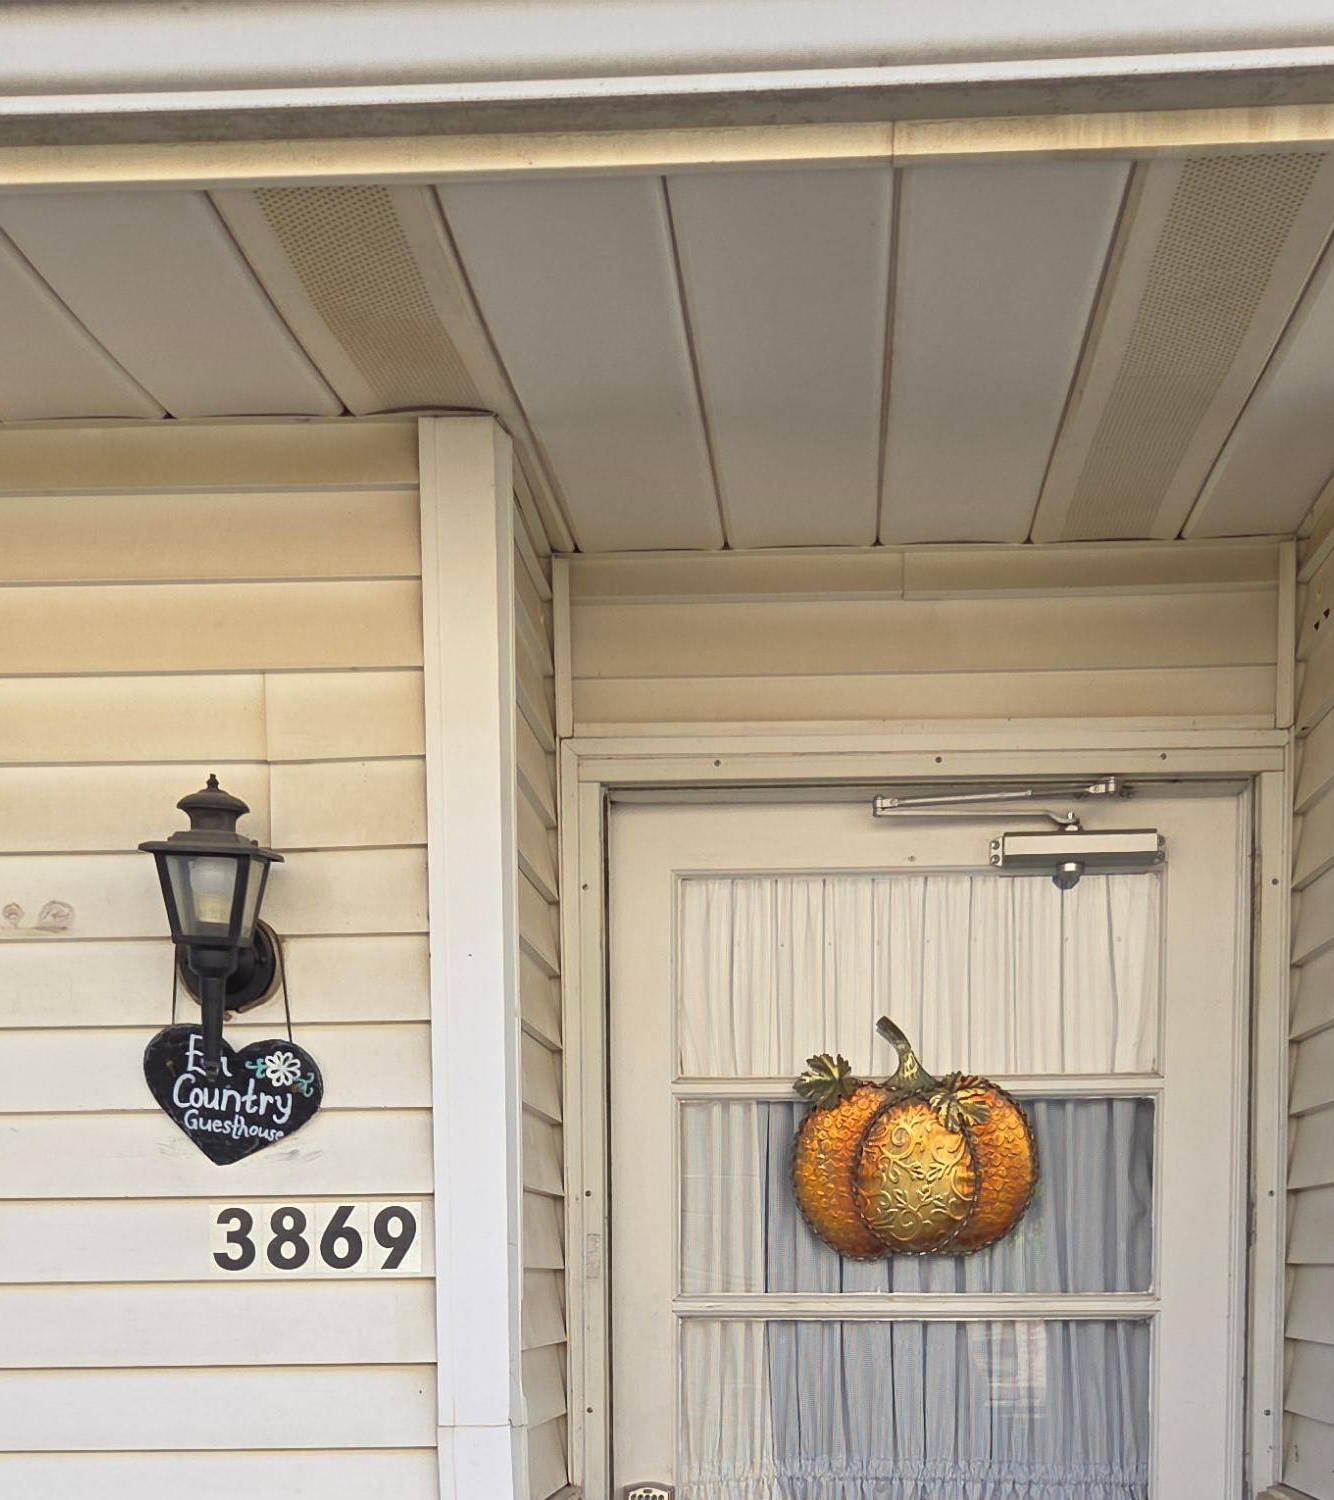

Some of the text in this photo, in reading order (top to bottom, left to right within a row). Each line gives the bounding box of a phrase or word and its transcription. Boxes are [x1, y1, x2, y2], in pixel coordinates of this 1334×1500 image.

[172, 1073, 292, 1124] Country
[183, 1109, 284, 1141] Guesthouse
[213, 1205, 417, 1272] 3869
